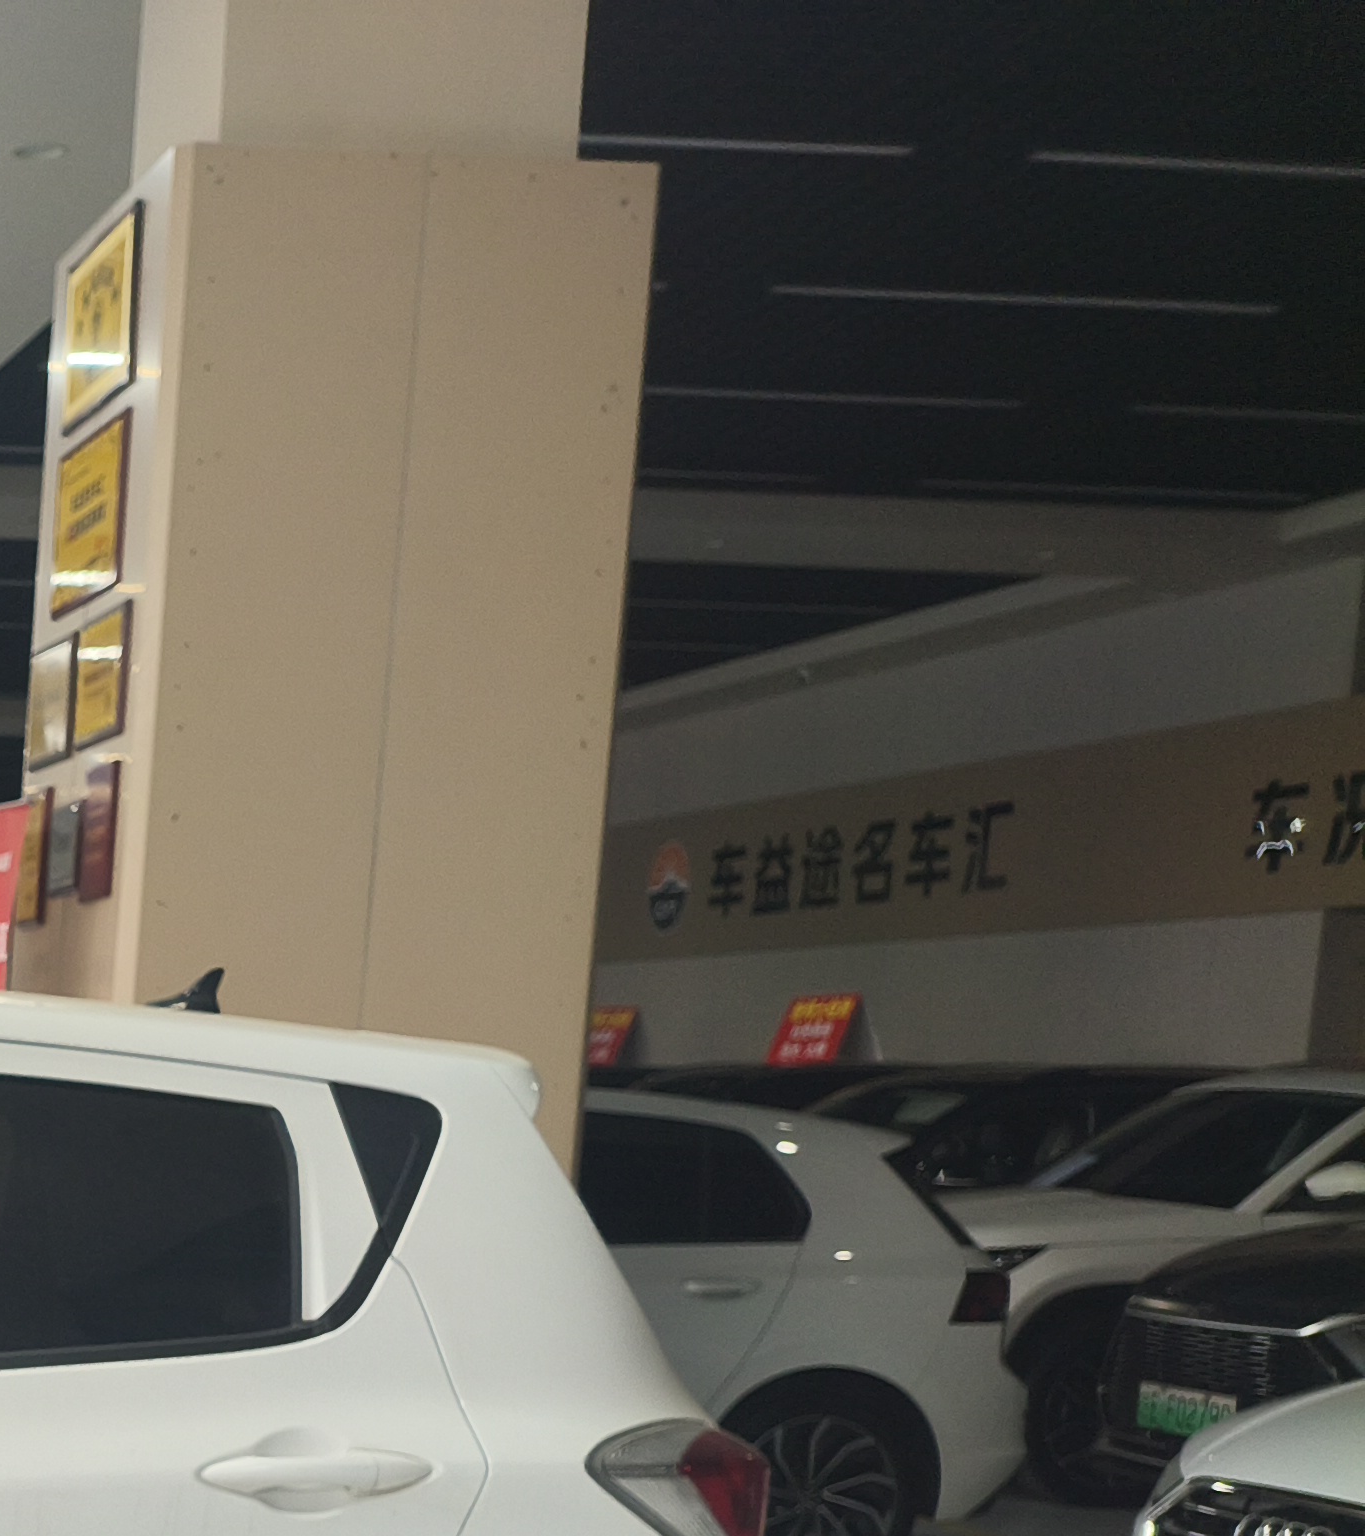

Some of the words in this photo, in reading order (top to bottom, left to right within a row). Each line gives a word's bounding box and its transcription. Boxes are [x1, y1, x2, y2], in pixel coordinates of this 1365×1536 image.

[706, 801, 1016, 919] 车益途名车汇
